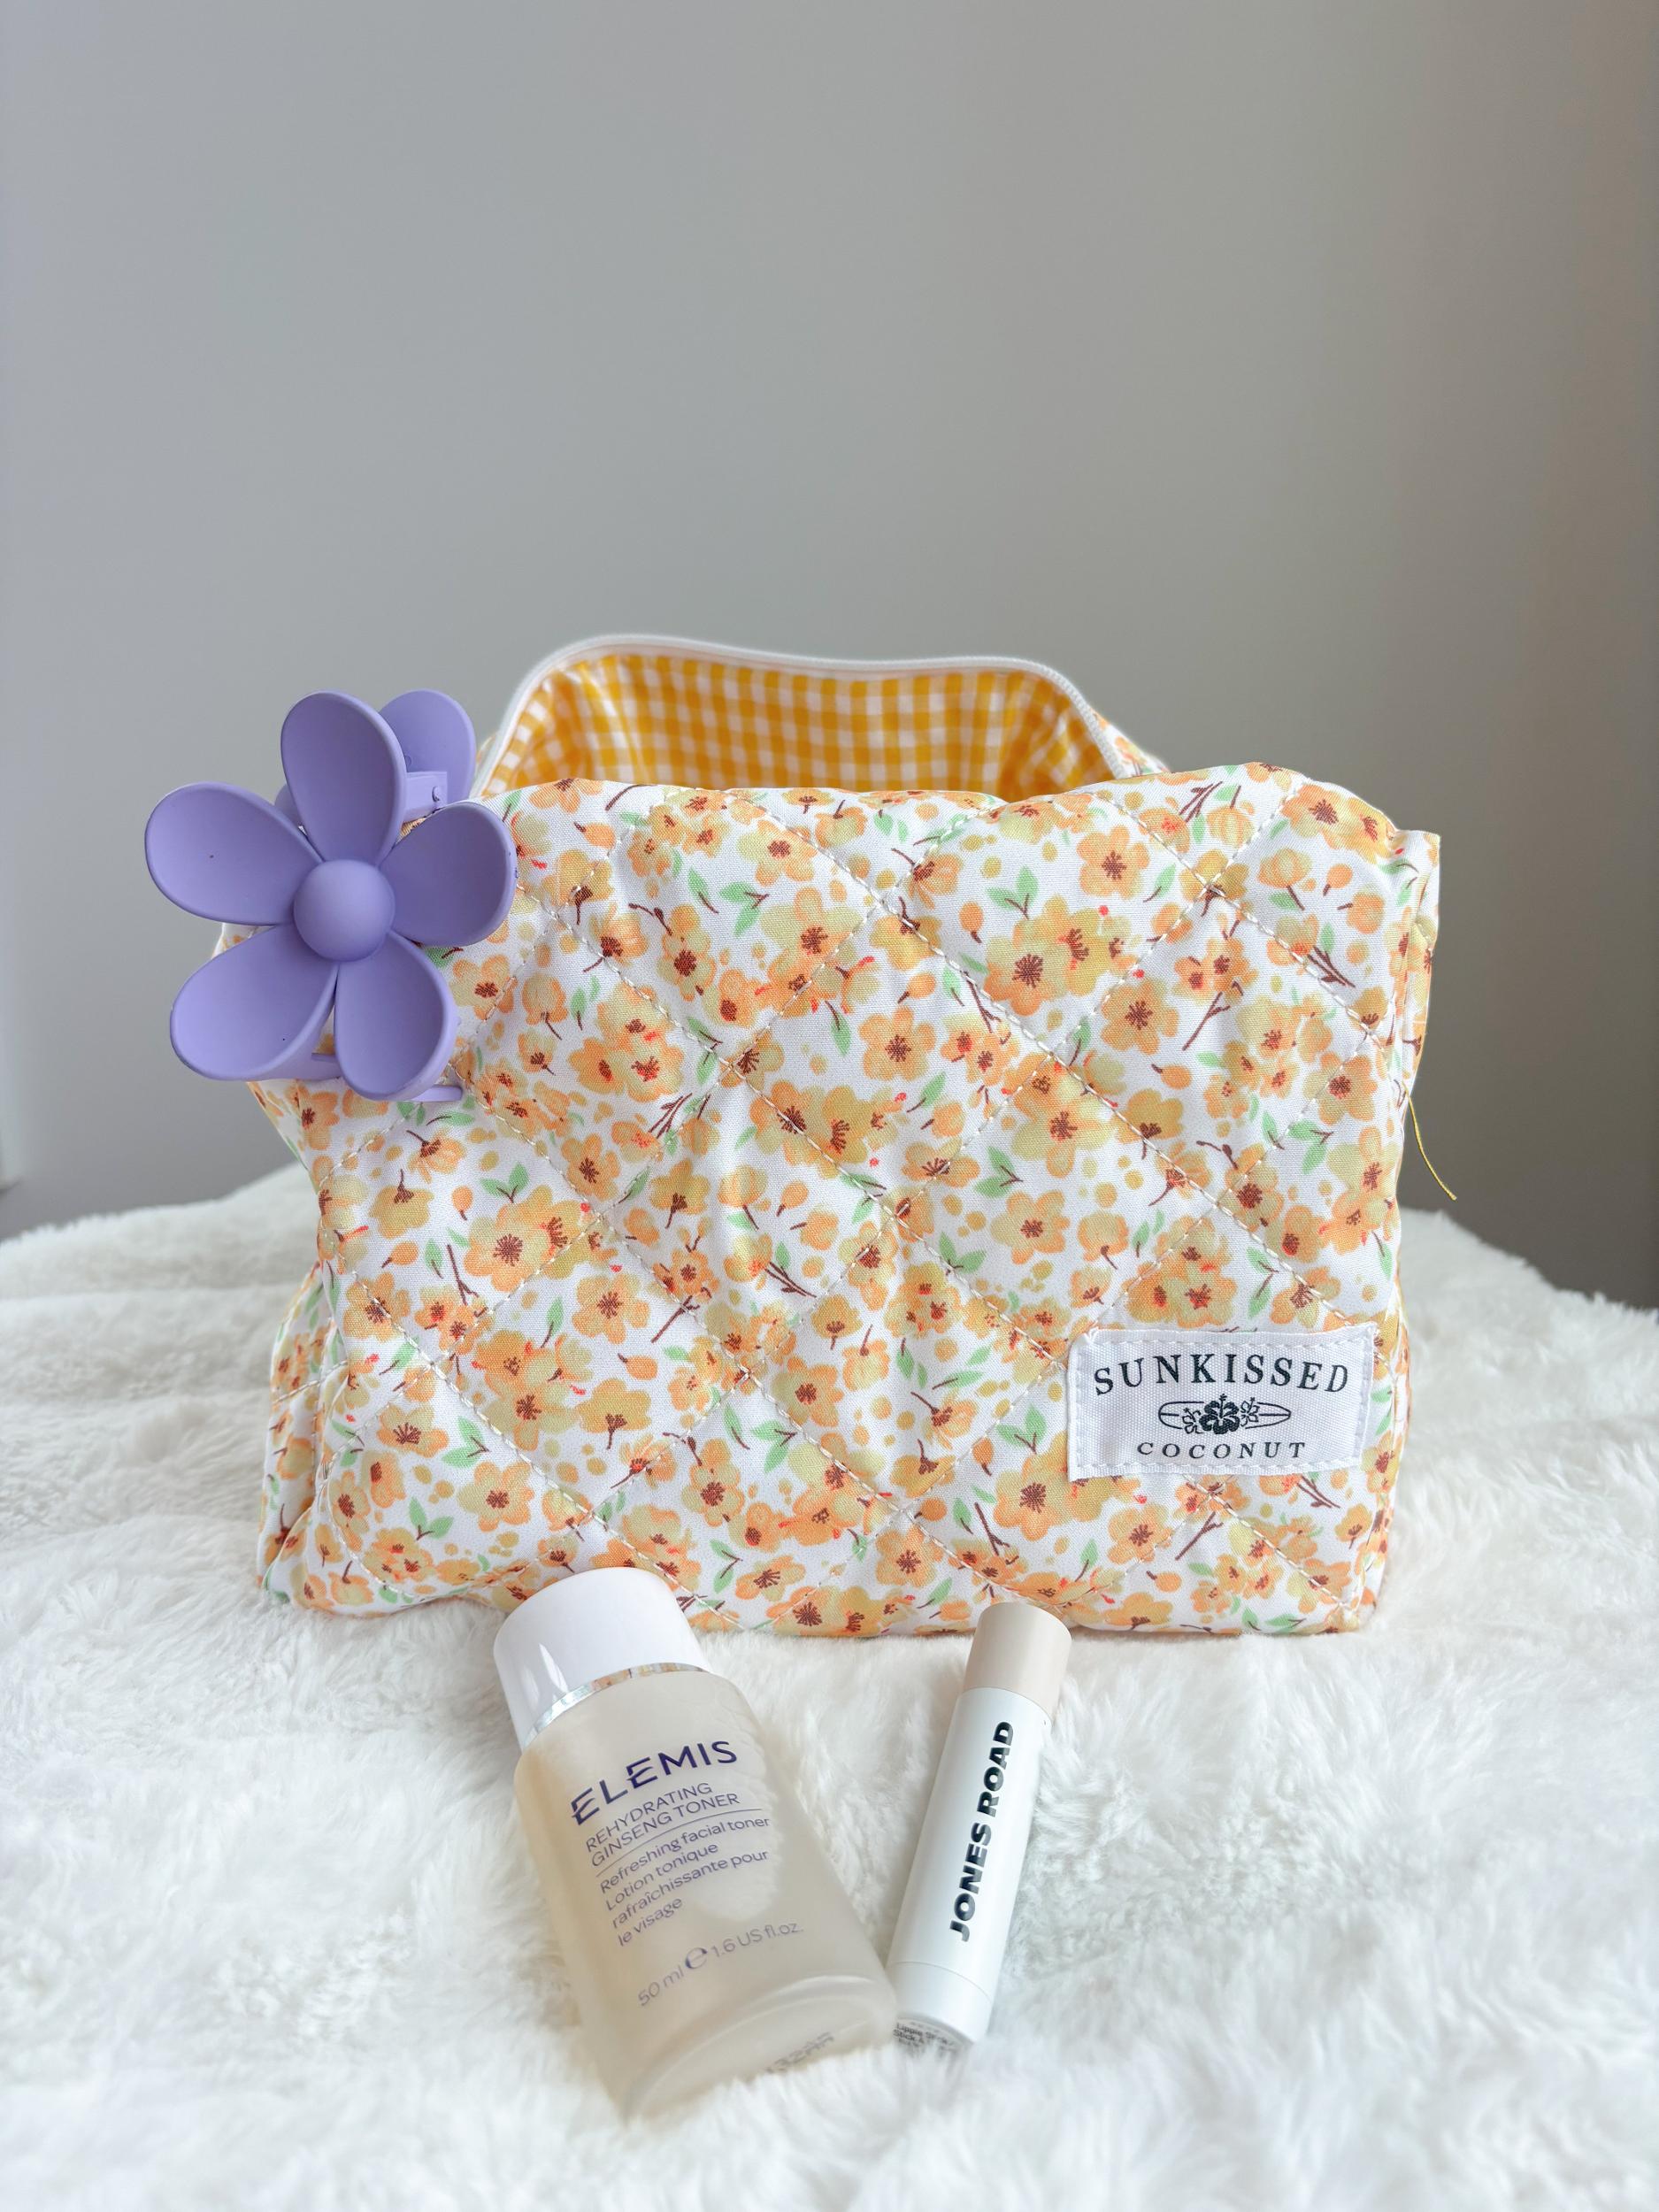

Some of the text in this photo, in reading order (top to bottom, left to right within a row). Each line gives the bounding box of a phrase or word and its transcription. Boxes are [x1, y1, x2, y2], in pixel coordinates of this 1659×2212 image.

[1094, 1353, 1349, 1396] SUNKISSED
[1137, 1441, 1306, 1459] COCONUT
[571, 1740, 737, 1825] ELEMIS
[586, 1782, 713, 1853] REHYDRATING
[591, 1793, 741, 1867] GINSENG TONER
[600, 1816, 770, 1894] Refreshing facial toner
[949, 1721, 1014, 1942] JONES ROAD
[605, 1843, 718, 1911] Lotion tonique
[612, 1849, 769, 1929] rafraîchissante pour
[618, 1897, 683, 1947] le visage
[637, 1981, 660, 2007] 50
[663, 1965, 685, 1989] ml
[710, 1937, 736, 1958] 1.6
[736, 1928, 763, 1947] US
